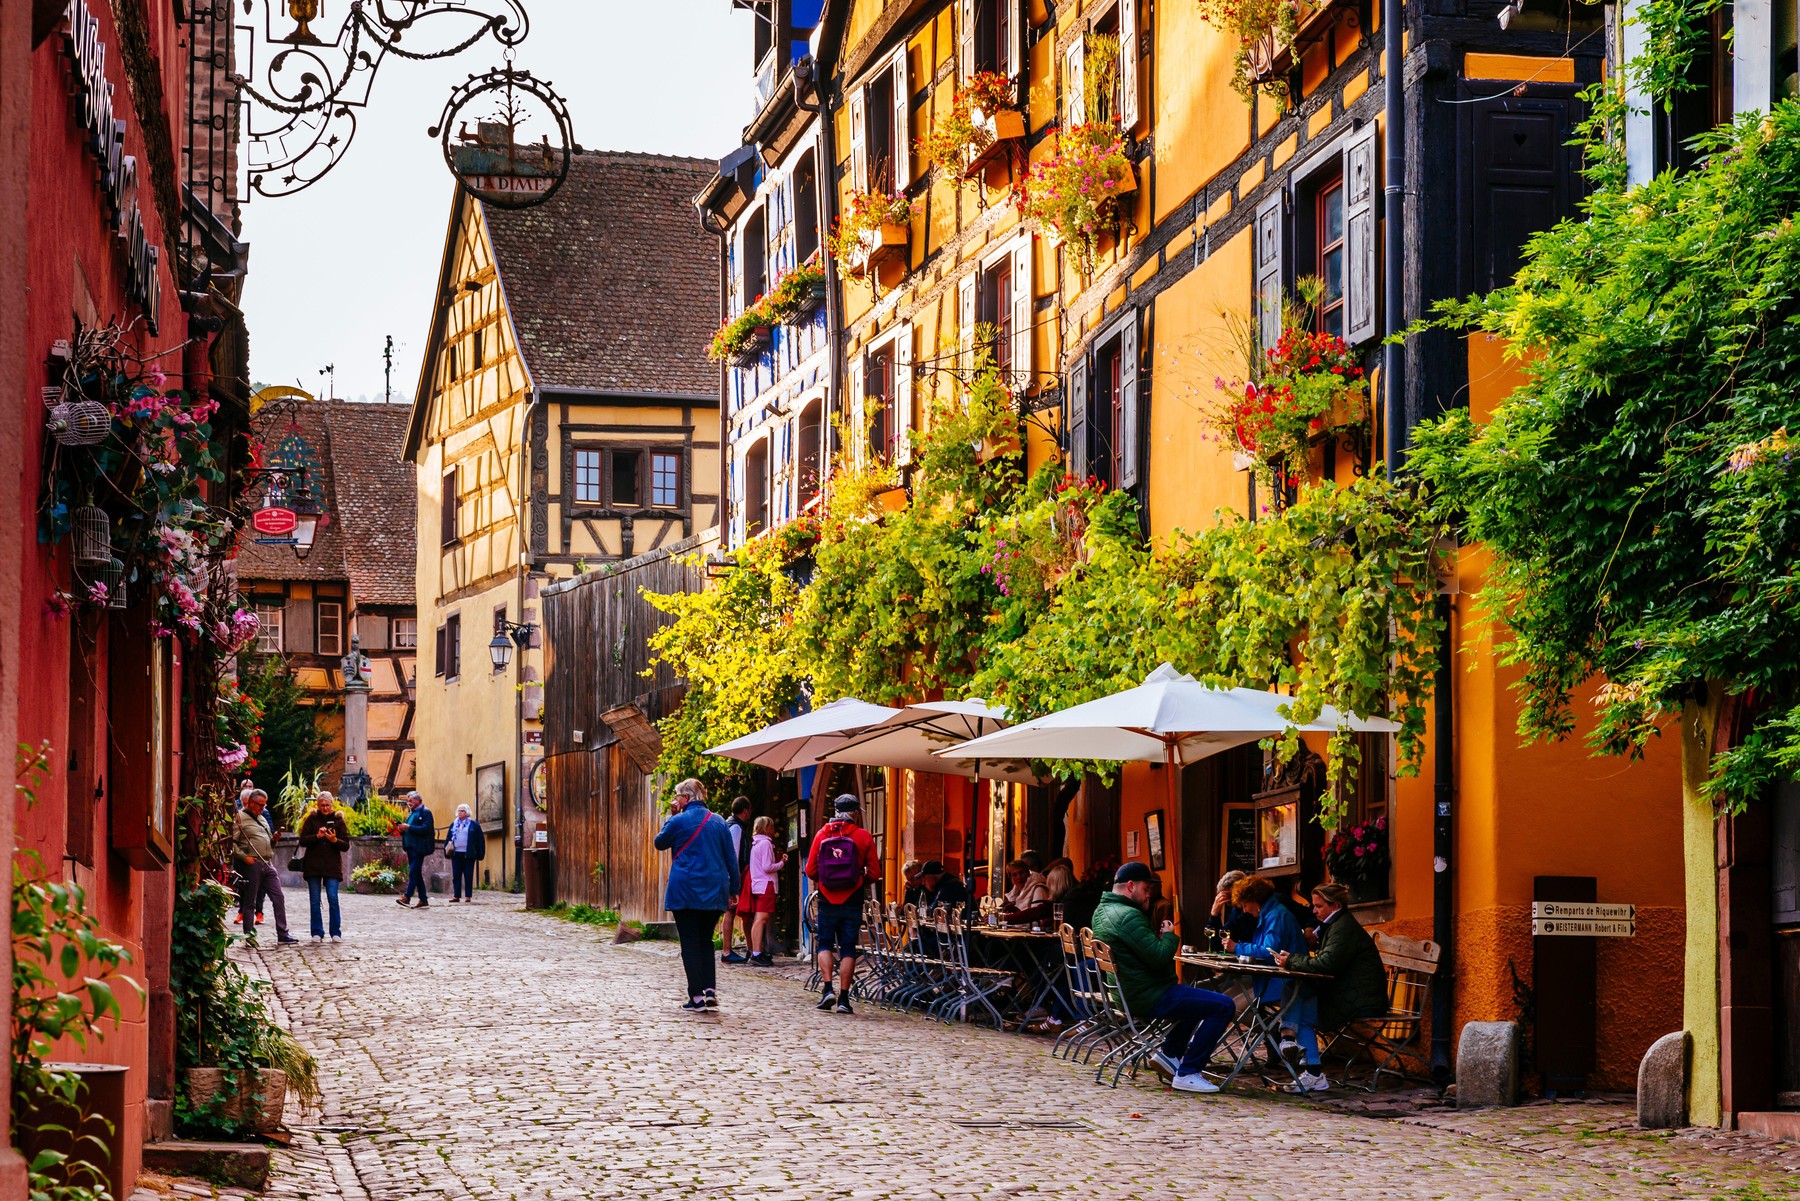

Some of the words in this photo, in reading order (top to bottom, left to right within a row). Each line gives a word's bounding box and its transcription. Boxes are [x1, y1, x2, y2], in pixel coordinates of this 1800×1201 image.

[475, 176, 495, 190] LA
[1555, 905, 1585, 916] Remparts
[1586, 906, 1594, 916] de
[1595, 906, 1627, 918] Riquewihr
[1555, 922, 1592, 932] MEISTERMANN
[1595, 923, 1611, 933] Robert
[1612, 924, 1616, 933] &
[1617, 923, 1627, 933] Fils
